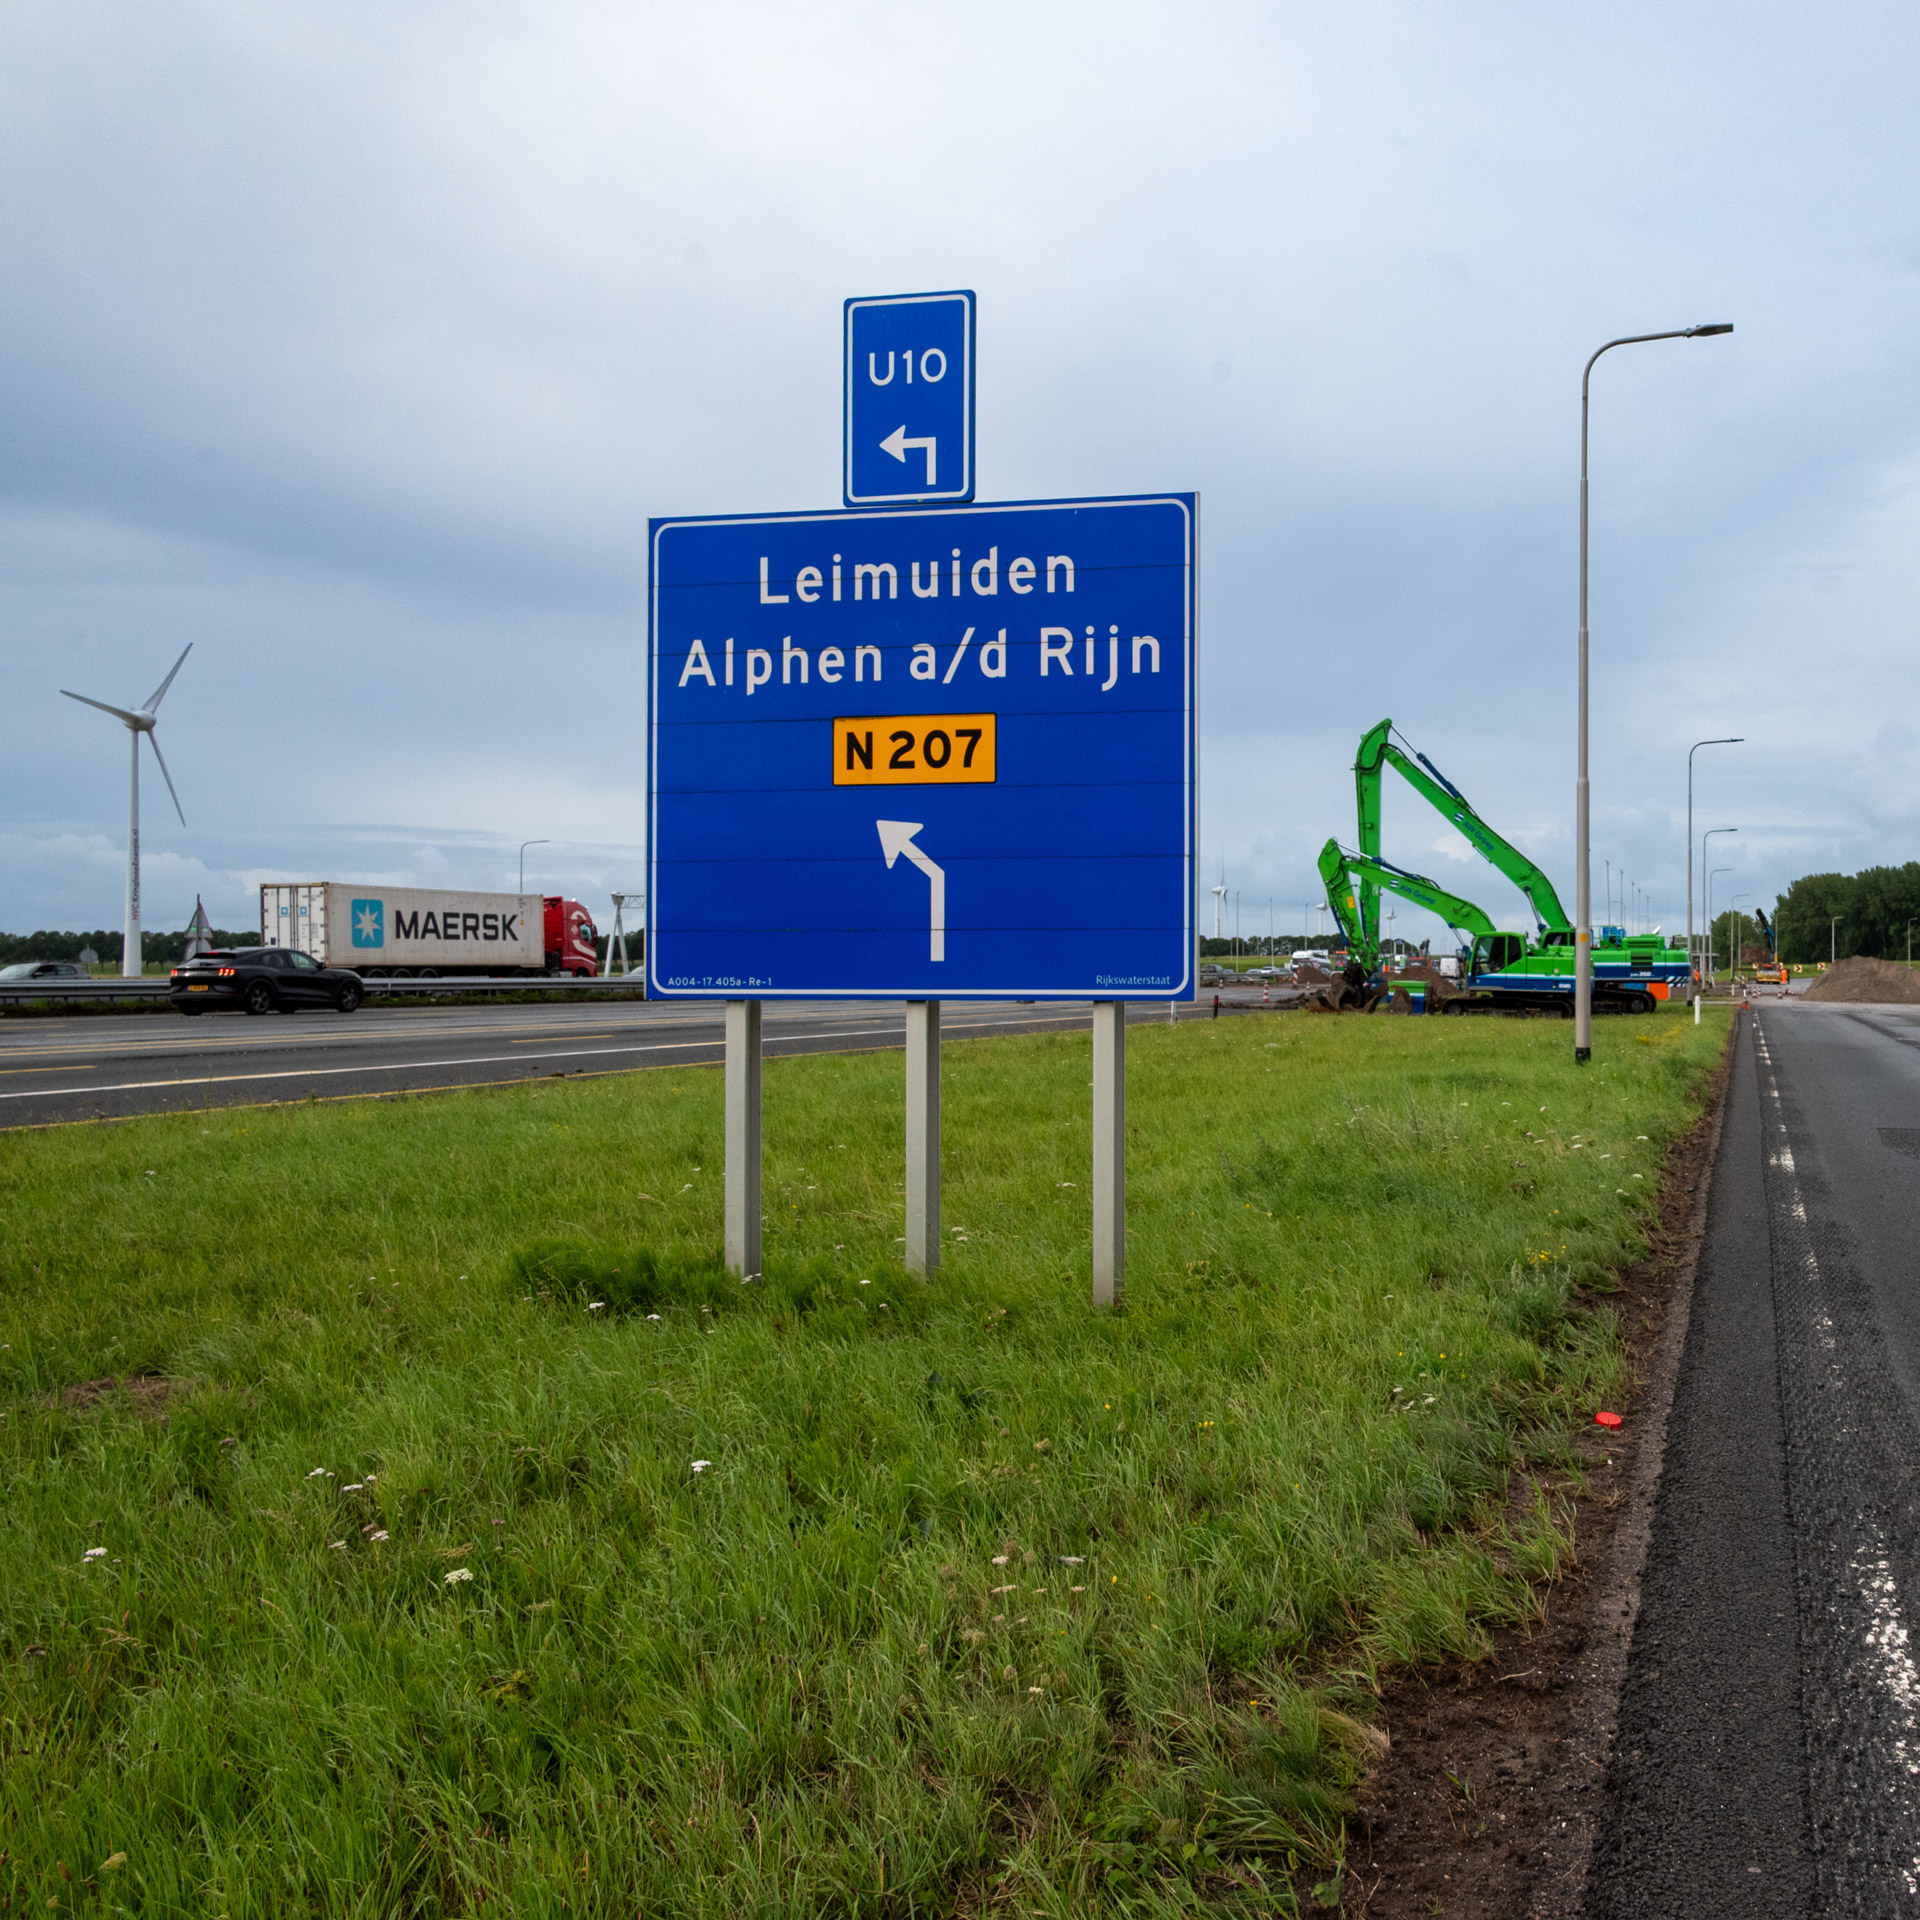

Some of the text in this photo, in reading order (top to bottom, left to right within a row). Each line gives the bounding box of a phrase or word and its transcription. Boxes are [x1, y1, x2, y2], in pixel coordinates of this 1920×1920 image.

[869, 347, 947, 386] U10
[759, 546, 1075, 604] Leimuiden
[678, 624, 1160, 696] Alphen a/d Rijn
[131, 904, 139, 921] HVC
[395, 910, 519, 942] MAERSK
[1096, 975, 1170, 987] Rijkswaterstaat
